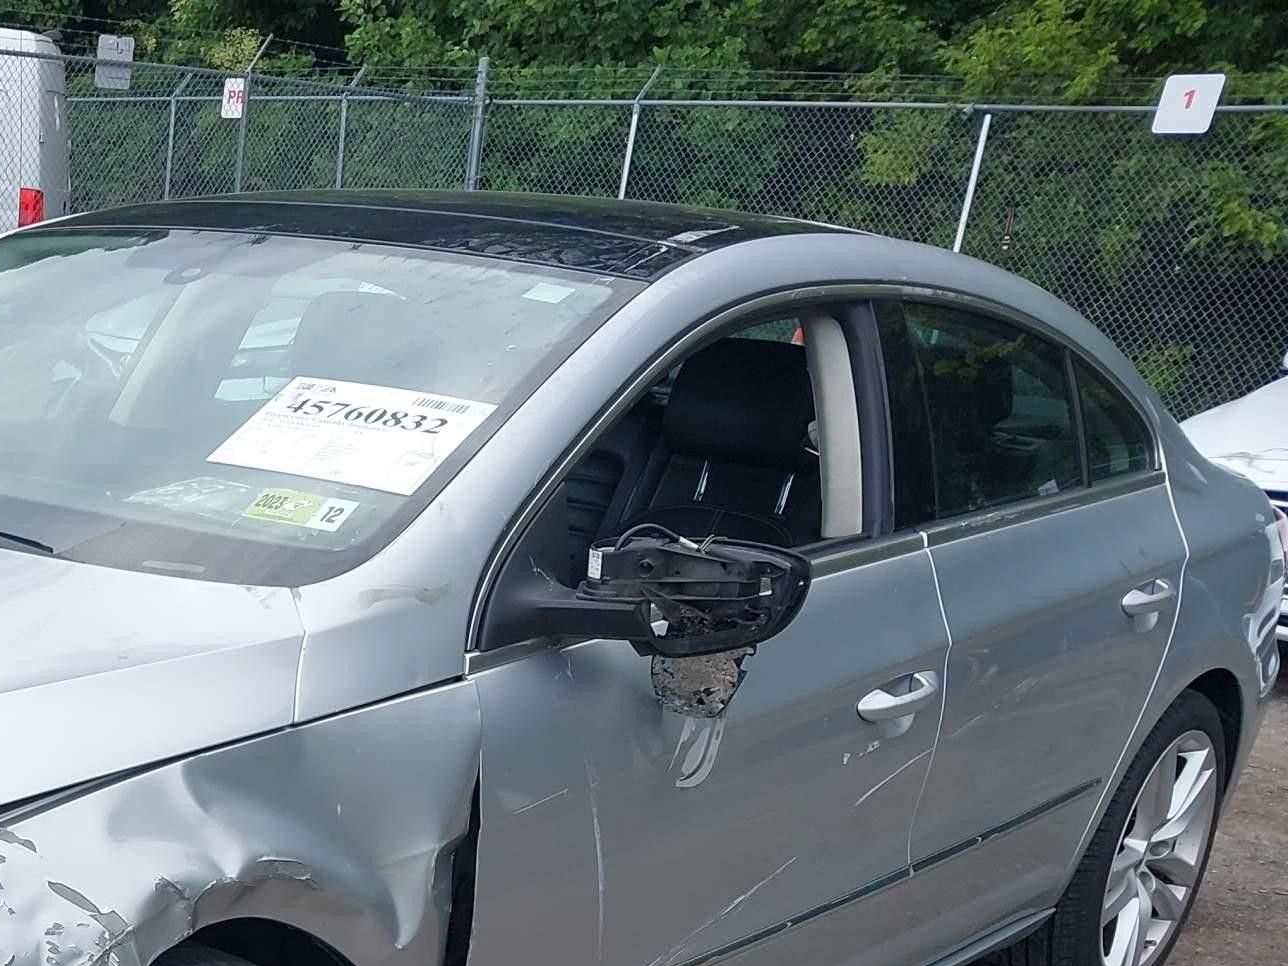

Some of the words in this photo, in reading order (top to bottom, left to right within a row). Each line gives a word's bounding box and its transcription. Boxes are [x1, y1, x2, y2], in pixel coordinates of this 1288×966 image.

[1183, 89, 1197, 110] 1
[286, 398, 449, 434] 45760832
[319, 506, 345, 523] 12
